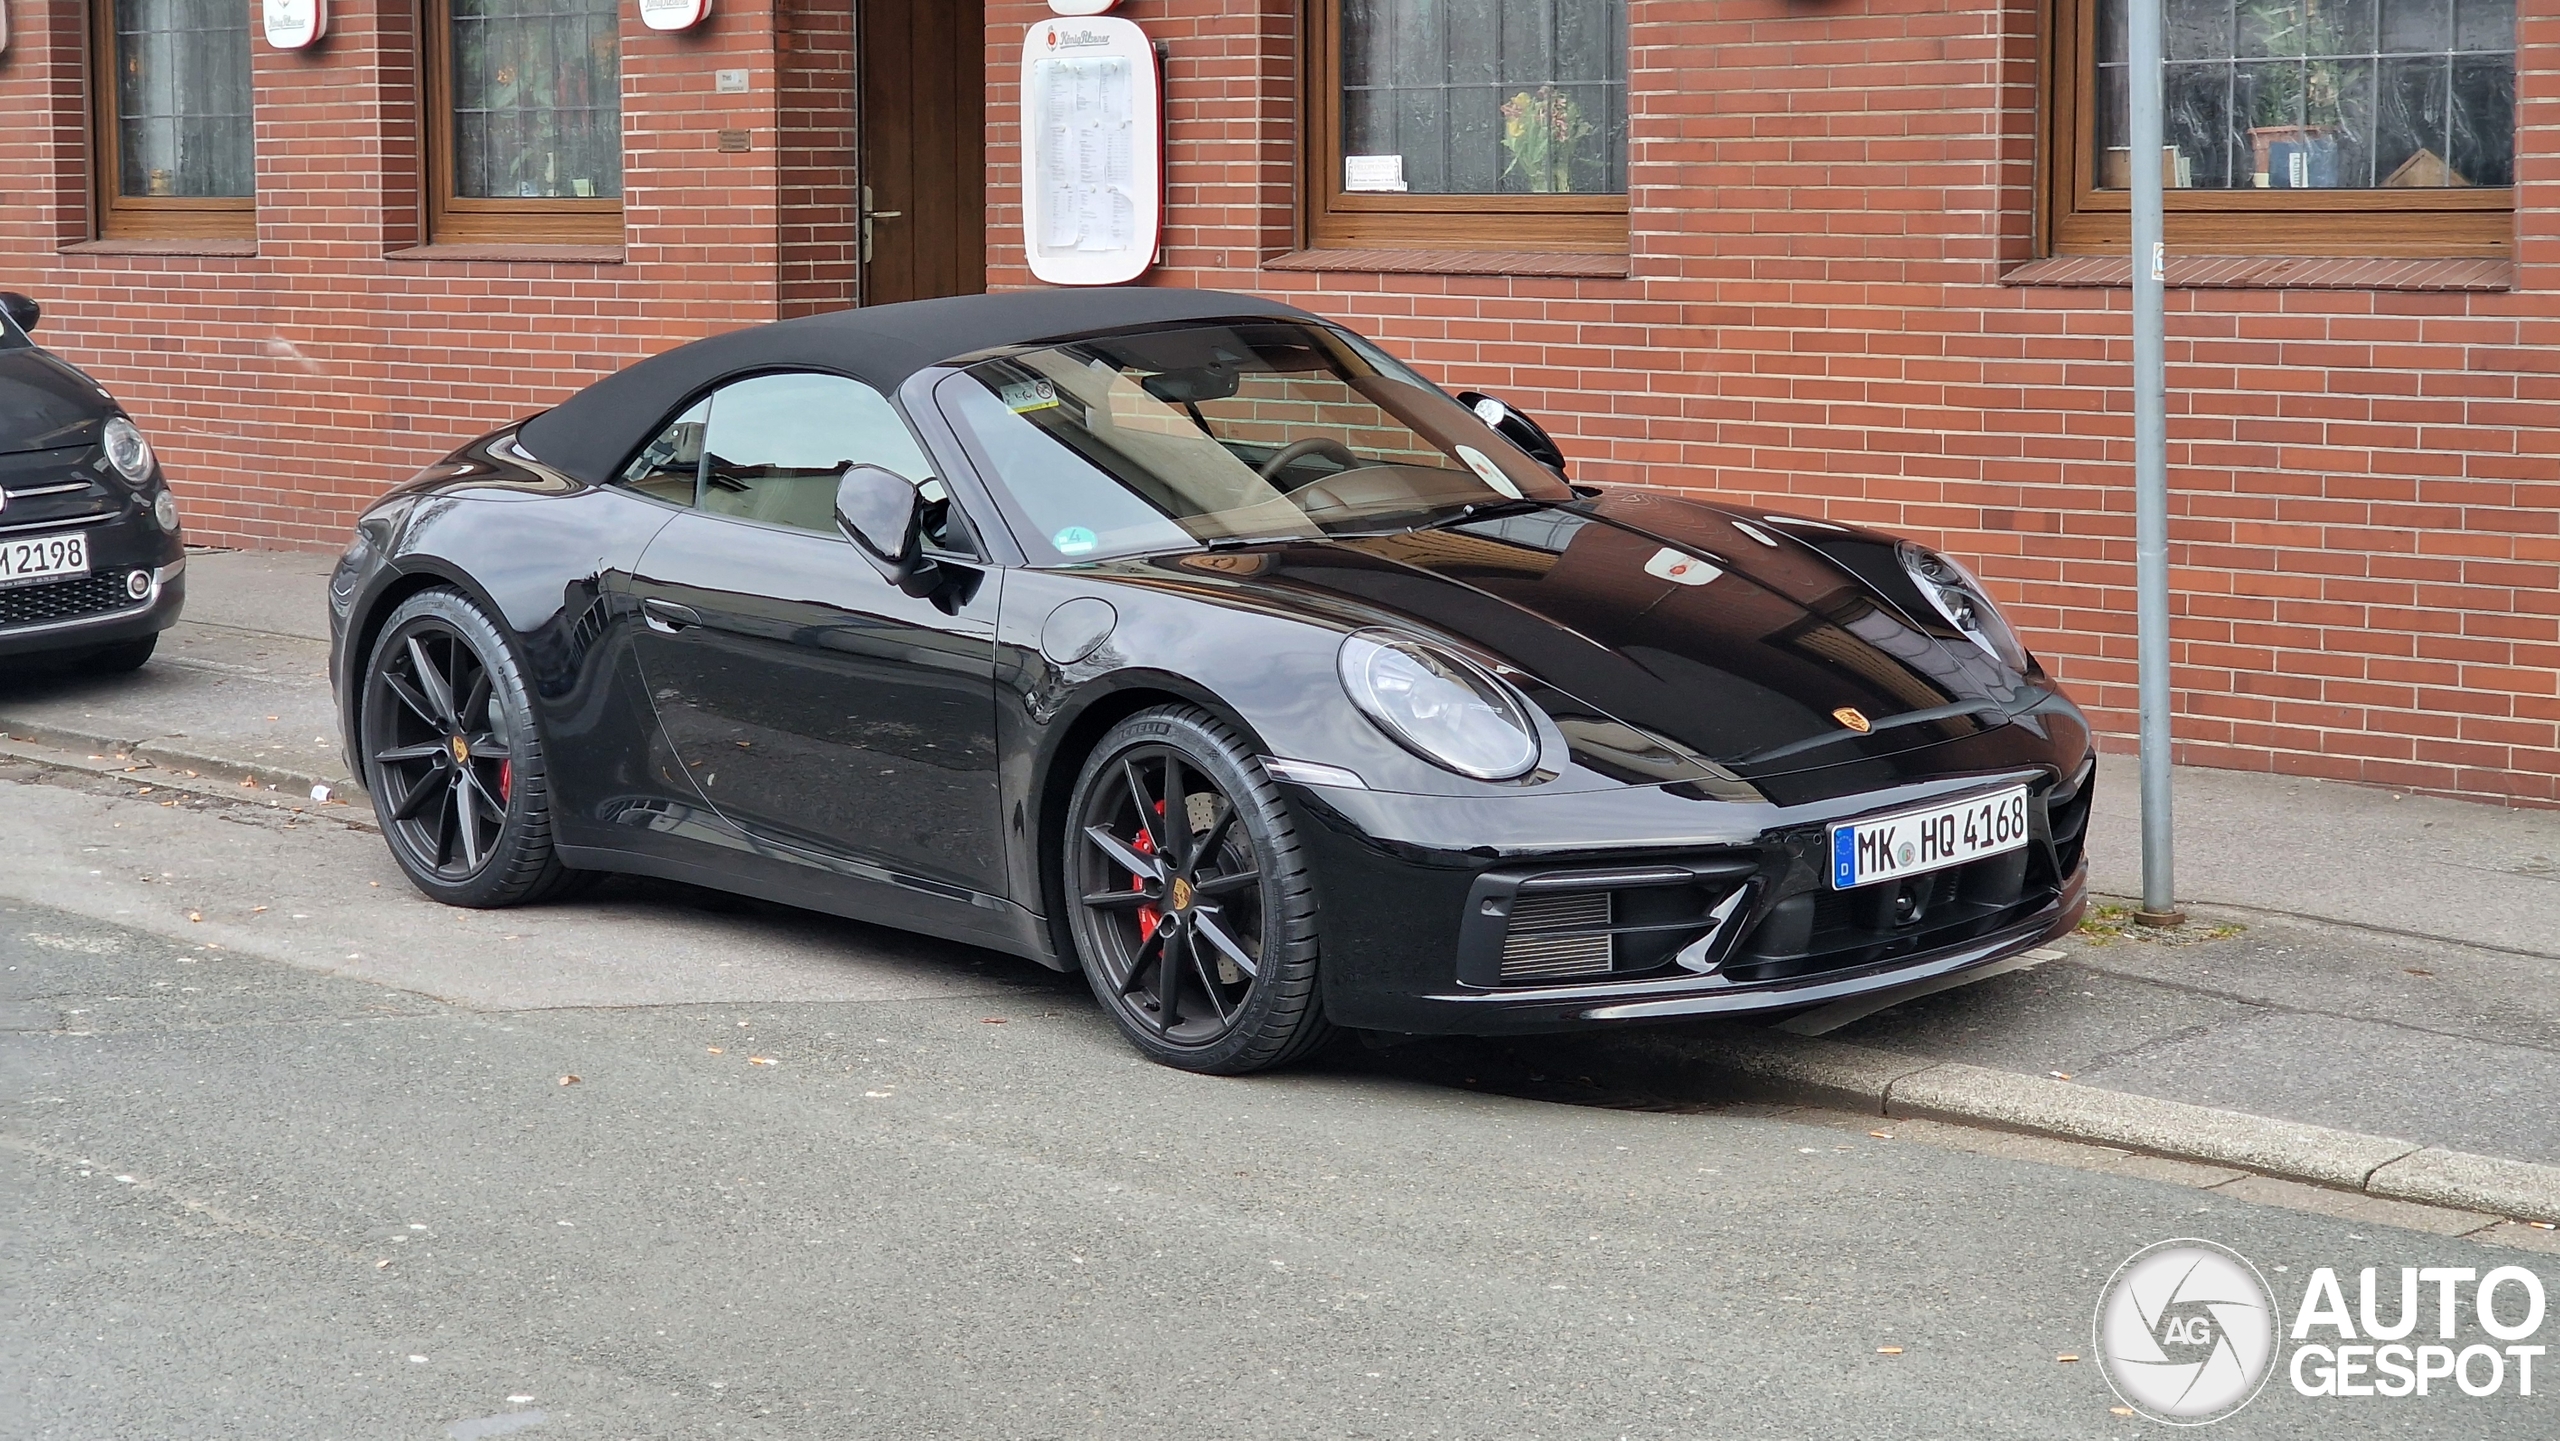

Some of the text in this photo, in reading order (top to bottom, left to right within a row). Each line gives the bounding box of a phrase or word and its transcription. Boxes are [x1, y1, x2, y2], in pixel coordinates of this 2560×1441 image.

[16, 539, 83, 574] 2198
[1841, 796, 2024, 877] D MK HQ 4168
